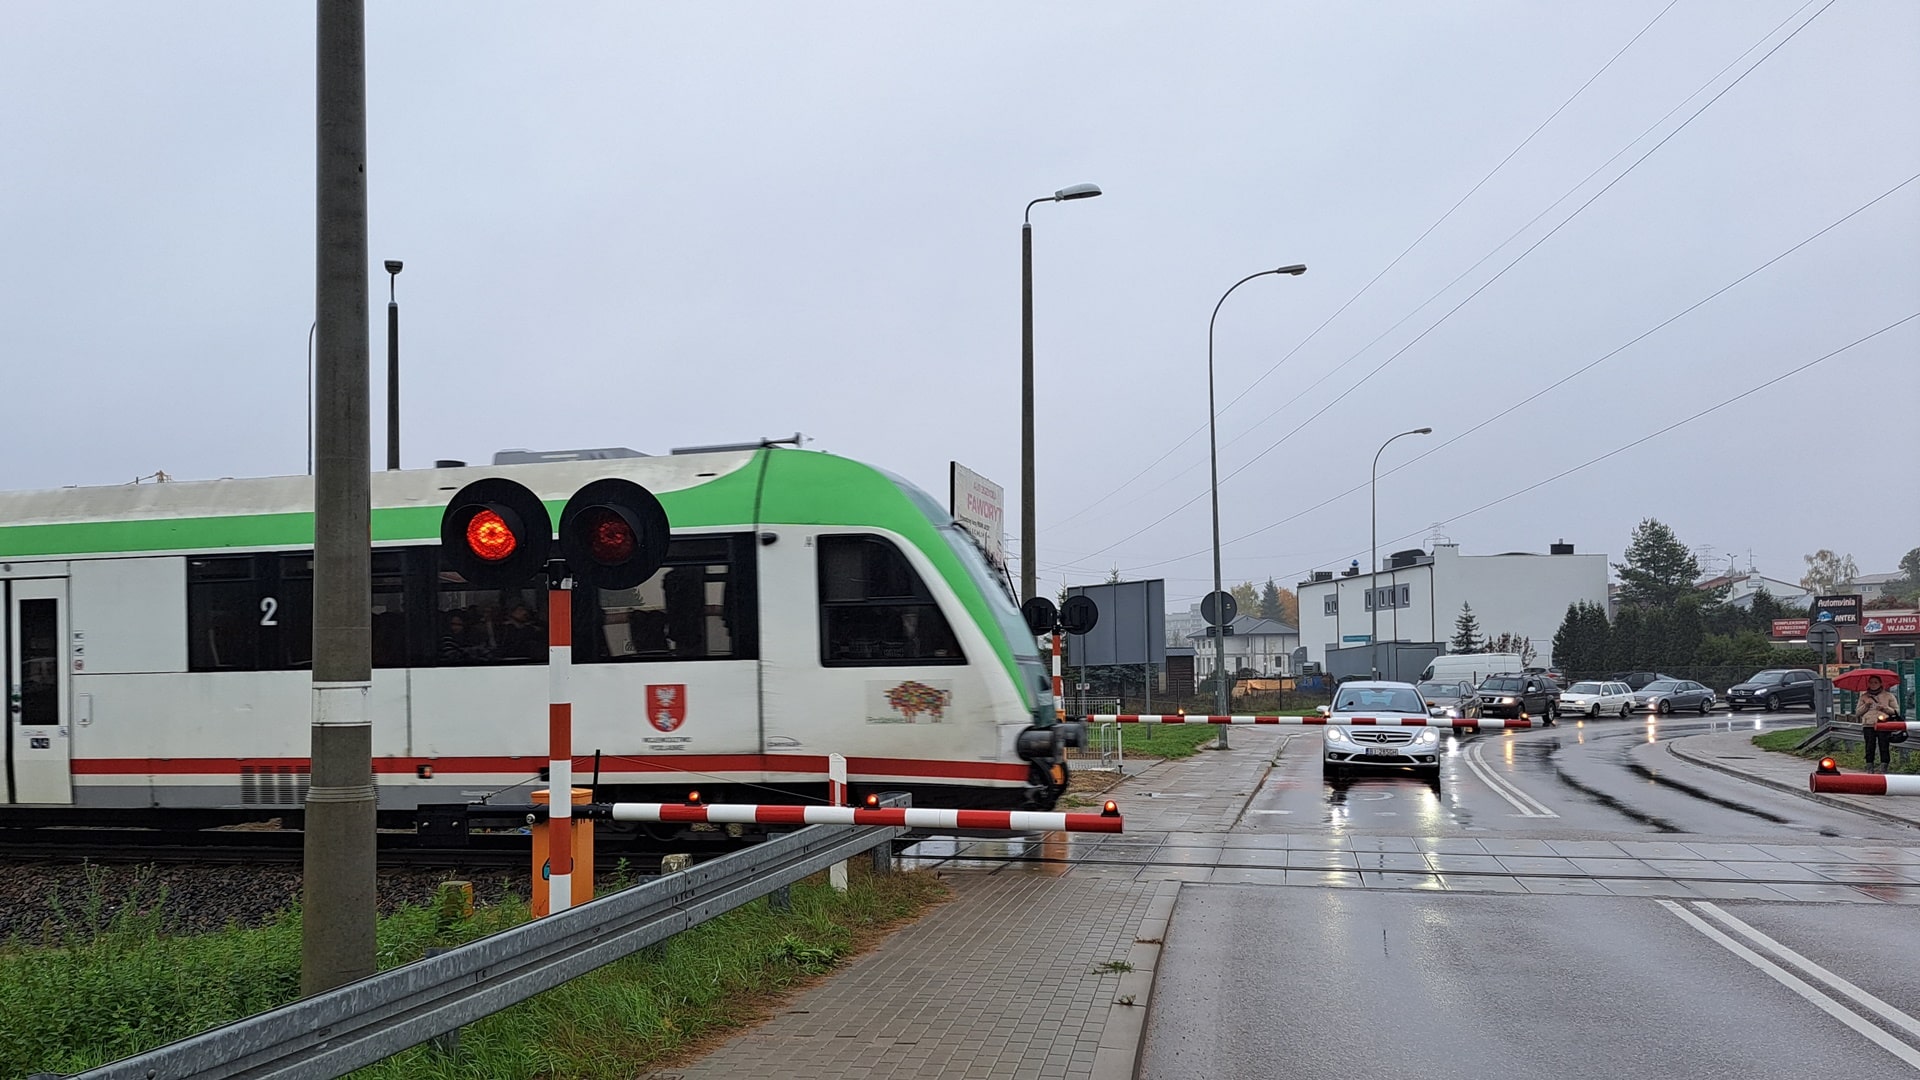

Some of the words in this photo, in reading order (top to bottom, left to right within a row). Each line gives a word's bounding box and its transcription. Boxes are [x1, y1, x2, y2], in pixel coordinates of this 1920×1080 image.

[967, 493, 1003, 522] FAWORYT
[1818, 597, 1856, 607] Automyjnia
[260, 597, 278, 625] 2
[1834, 614, 1856, 622] ANTEK
[1886, 617, 1917, 625] MYJNIA
